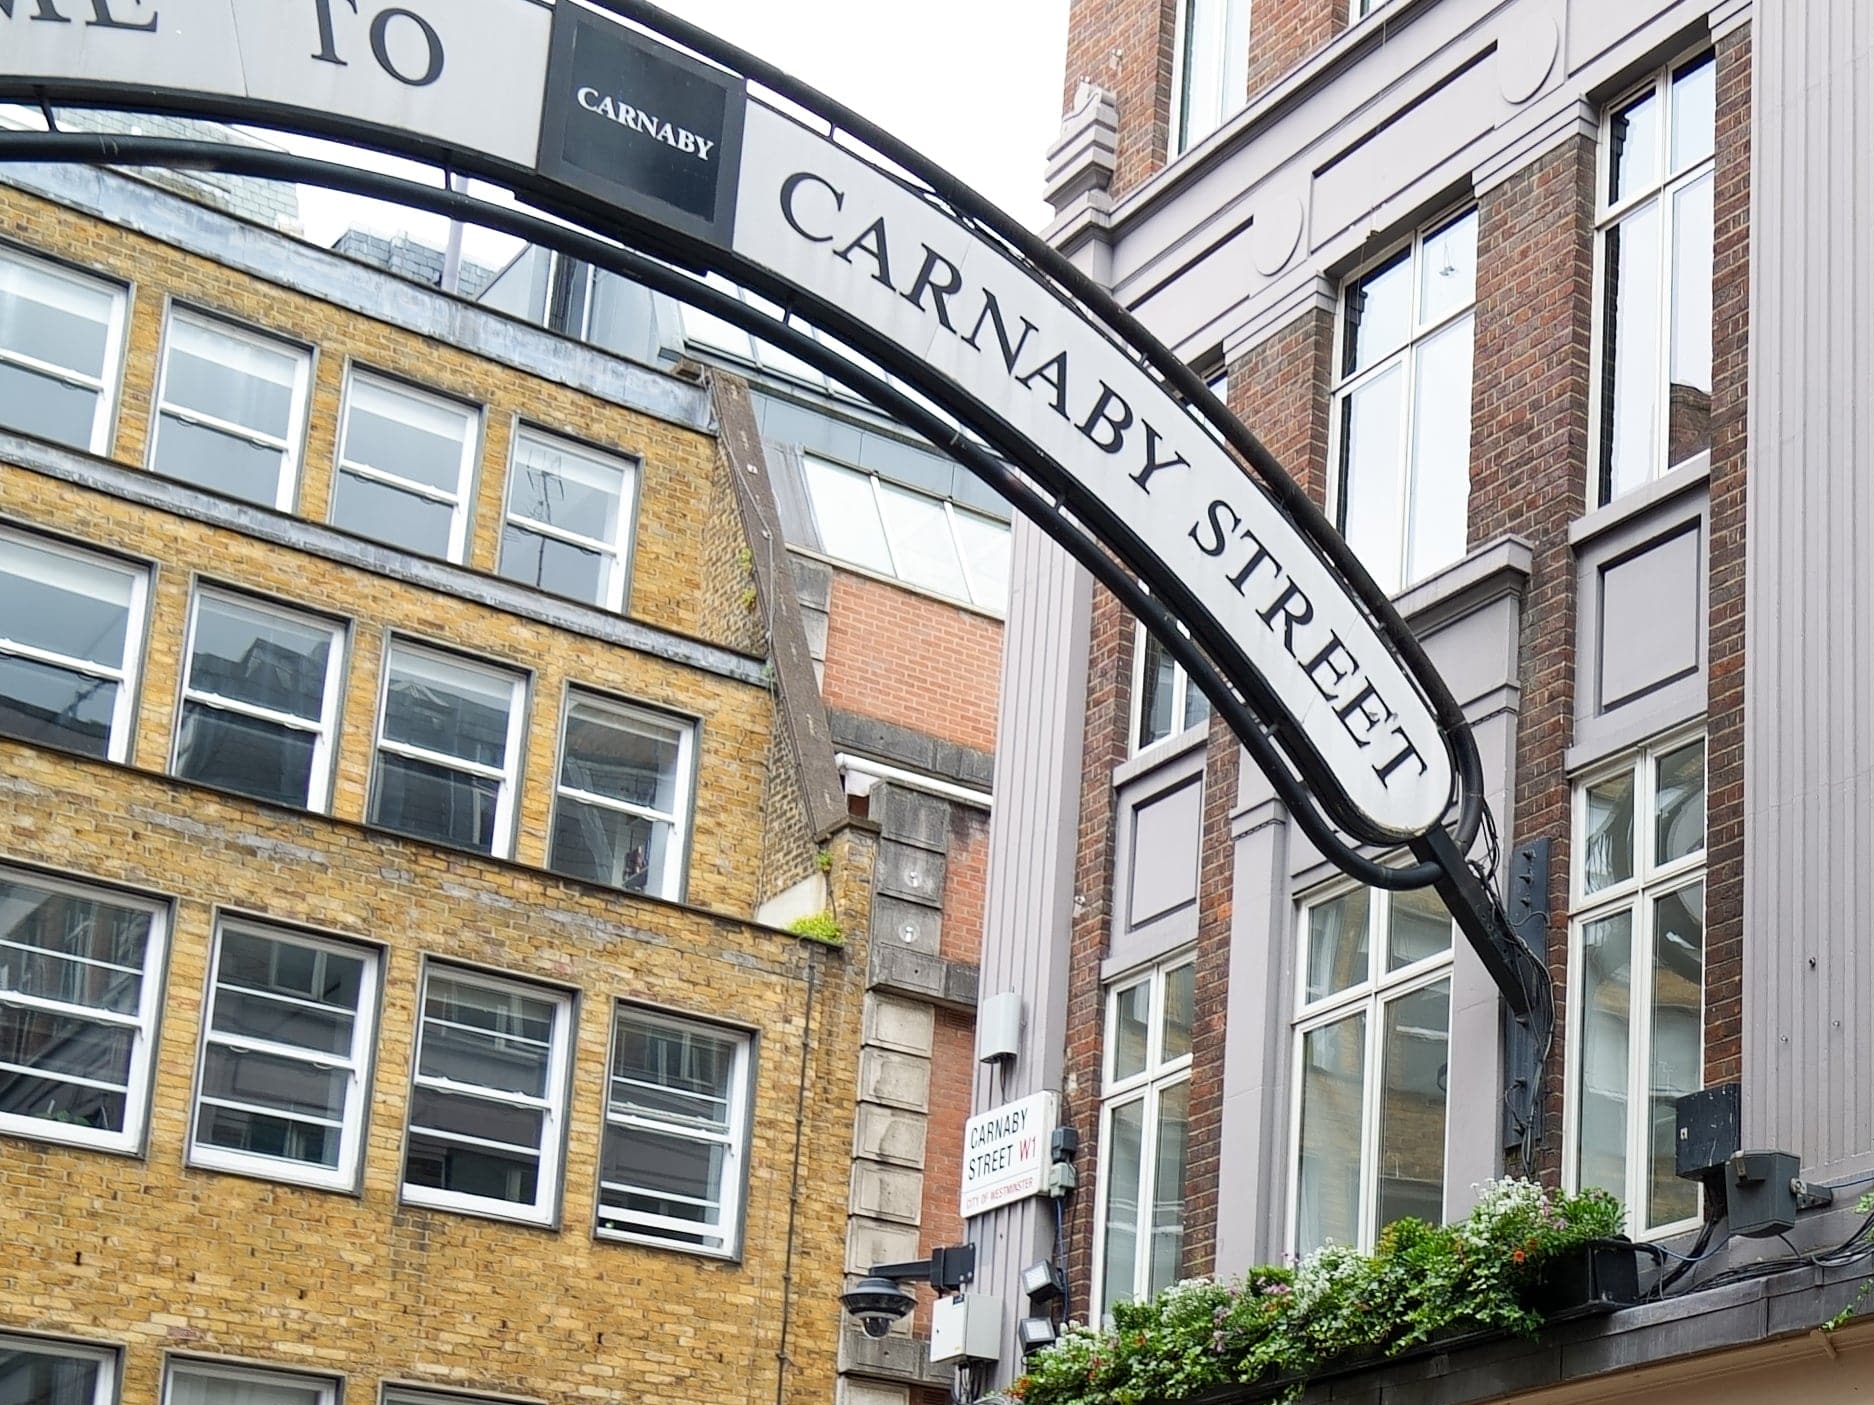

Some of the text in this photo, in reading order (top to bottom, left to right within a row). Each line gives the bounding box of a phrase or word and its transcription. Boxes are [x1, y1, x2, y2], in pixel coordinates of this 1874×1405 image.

[311, 0, 445, 86] TO
[577, 87, 714, 161] CARNABY
[779, 171, 1430, 790] CARNABY STREET
[970, 1107, 1028, 1150] CARNABY
[968, 1136, 1037, 1181] STREET W1
[966, 1176, 1033, 1210] CITY OF WESTMINSTER
